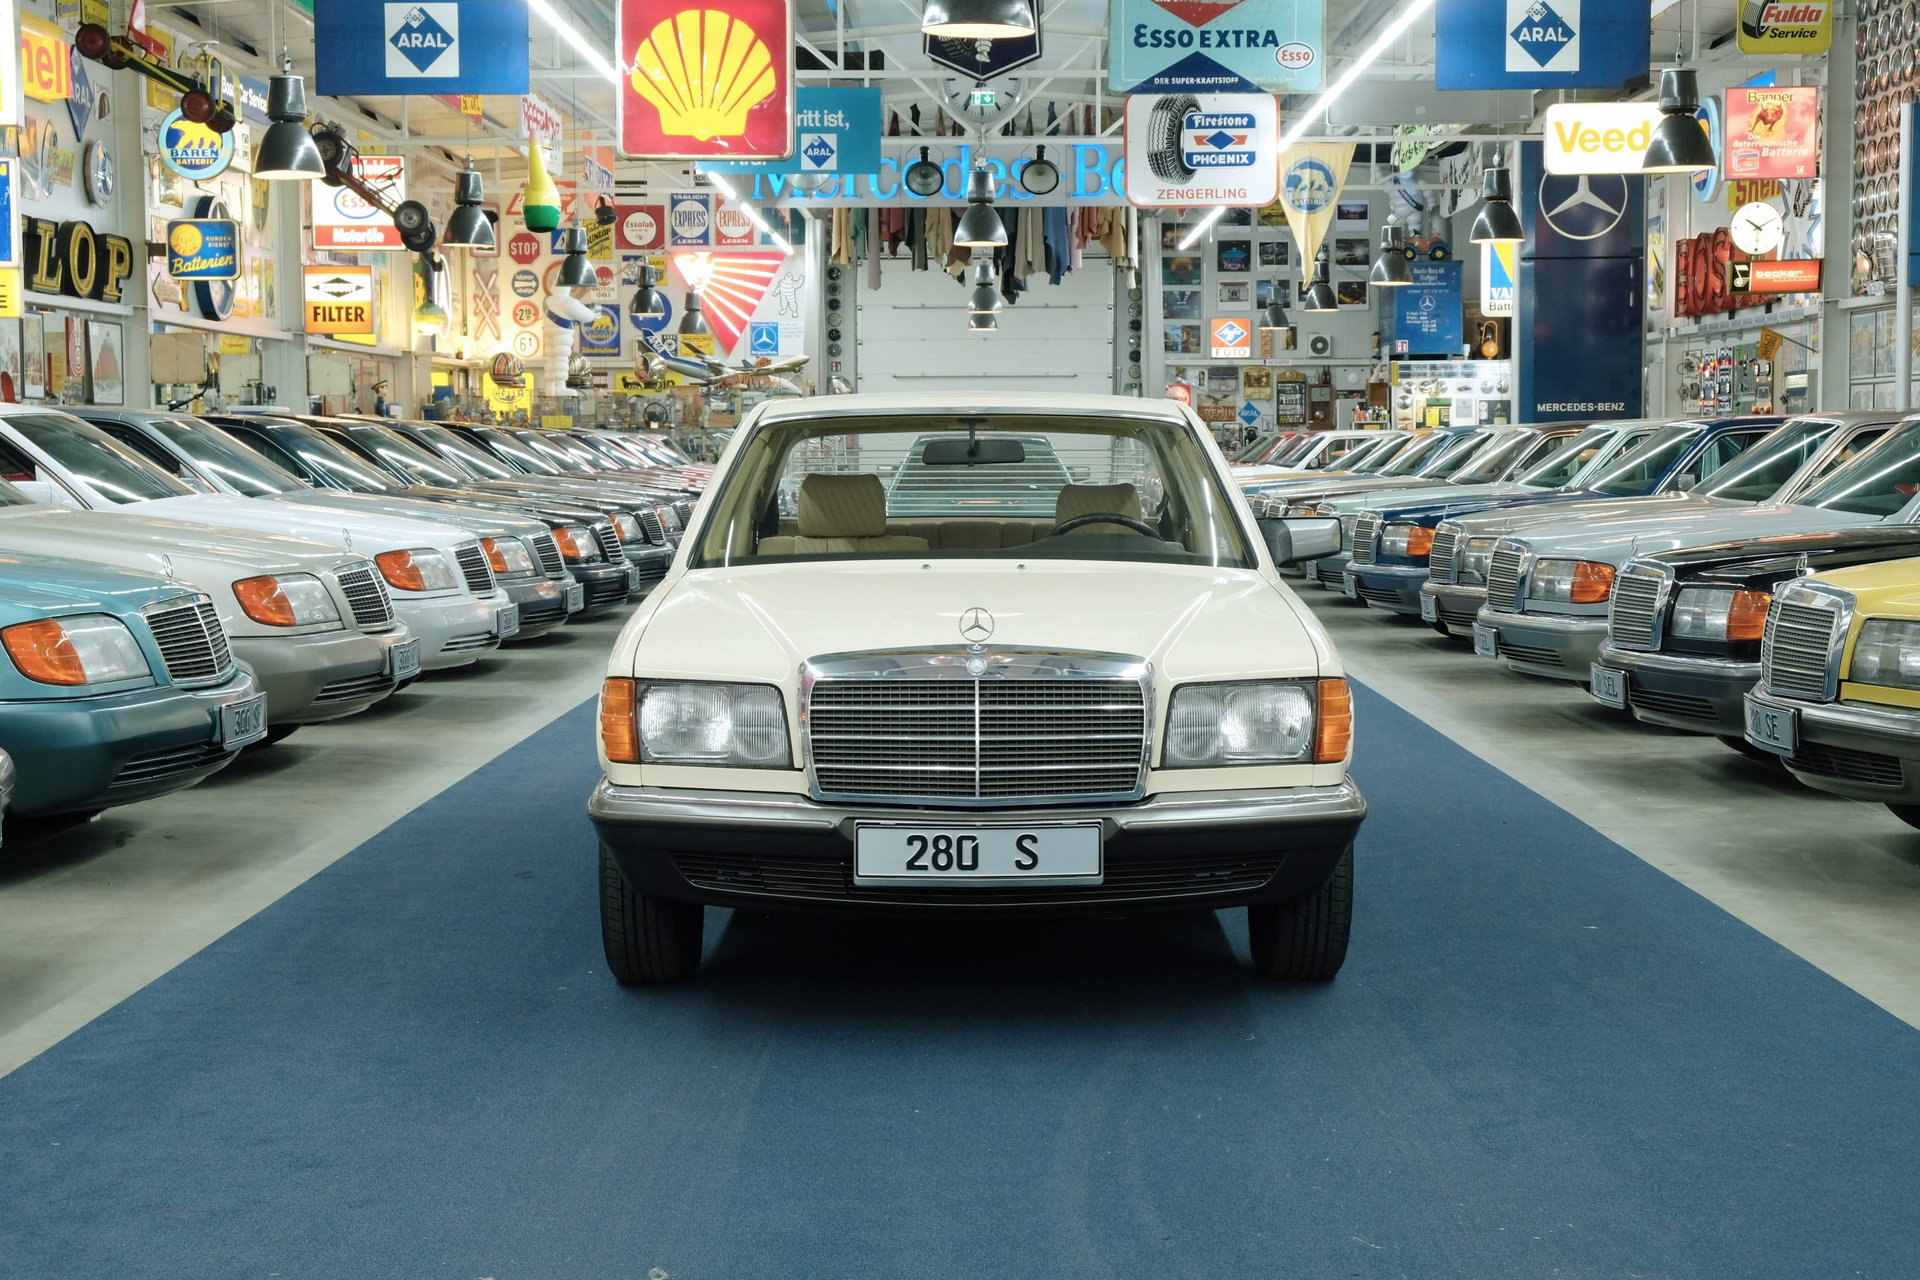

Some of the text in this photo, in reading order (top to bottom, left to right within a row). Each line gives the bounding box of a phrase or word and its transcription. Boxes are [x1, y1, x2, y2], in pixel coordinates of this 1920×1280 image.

[1763, 6, 1822, 23] Fulda
[397, 33, 448, 48] ARAL
[1200, 30, 1280, 48] EXTRA
[1518, 27, 1569, 42] ARAL
[1769, 28, 1817, 38] Service
[22, 38, 71, 97] ell
[1154, 77, 1239, 85] DER SUPER-KRAFTSTOFF
[1747, 91, 1795, 103] Banner
[823, 110, 850, 130] ist,
[1192, 115, 1249, 128] Firestone
[807, 148, 831, 156] ARAL
[1192, 154, 1249, 164] PHOENIX
[1762, 147, 1810, 156] Batterie
[341, 194, 375, 208] Ess
[1157, 188, 1248, 199] ZENGERLING
[625, 220, 655, 228] Essolub
[674, 210, 706, 227] EXPRESS
[719, 210, 751, 227] EXPRESS
[510, 242, 539, 255] STOP
[22, 216, 131, 302] LOP
[171, 253, 234, 275] Batterien
[1755, 270, 1803, 278] becker
[313, 306, 365, 322] FILTER
[646, 335, 664, 353] ANA
[1215, 347, 1246, 356] FOTO
[495, 390, 523, 398] HELLA
[1537, 402, 1625, 412] MERCEDES-BENZ
[1604, 674, 1618, 697] SEL
[235, 707, 250, 736] 300
[1766, 712, 1780, 741] SE
[906, 833, 1038, 871] 280 S
